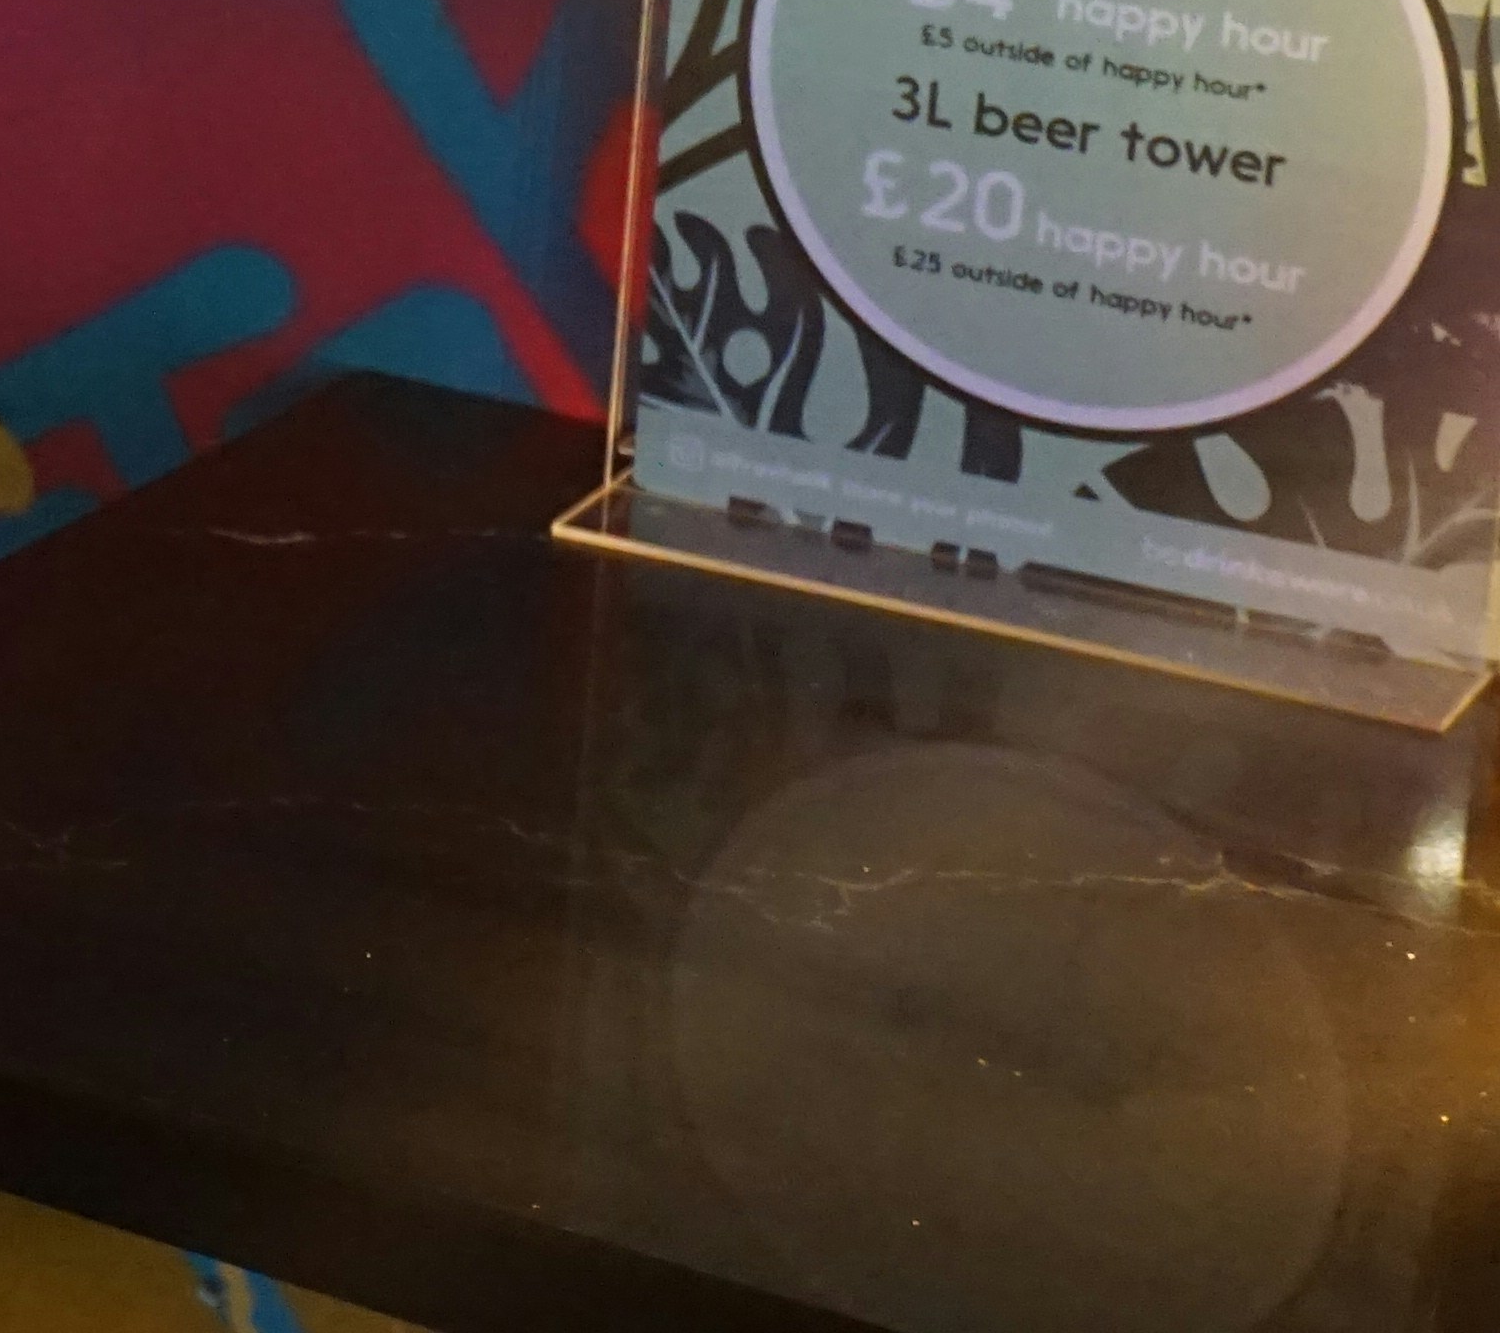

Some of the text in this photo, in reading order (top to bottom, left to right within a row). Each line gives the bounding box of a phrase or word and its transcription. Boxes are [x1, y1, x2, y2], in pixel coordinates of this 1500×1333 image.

[921, 23, 953, 48] £5
[963, 30, 1056, 67] outside
[1065, 49, 1094, 73] of
[1102, 55, 1184, 94] happy
[1219, 9, 1330, 63] hour
[891, 75, 1287, 187] 3L beer tower
[860, 148, 1308, 294] £20 happy hour
[891, 244, 942, 274] £25
[950, 259, 1045, 297] outside
[1051, 277, 1080, 302] of
[1090, 284, 1174, 324] happy
